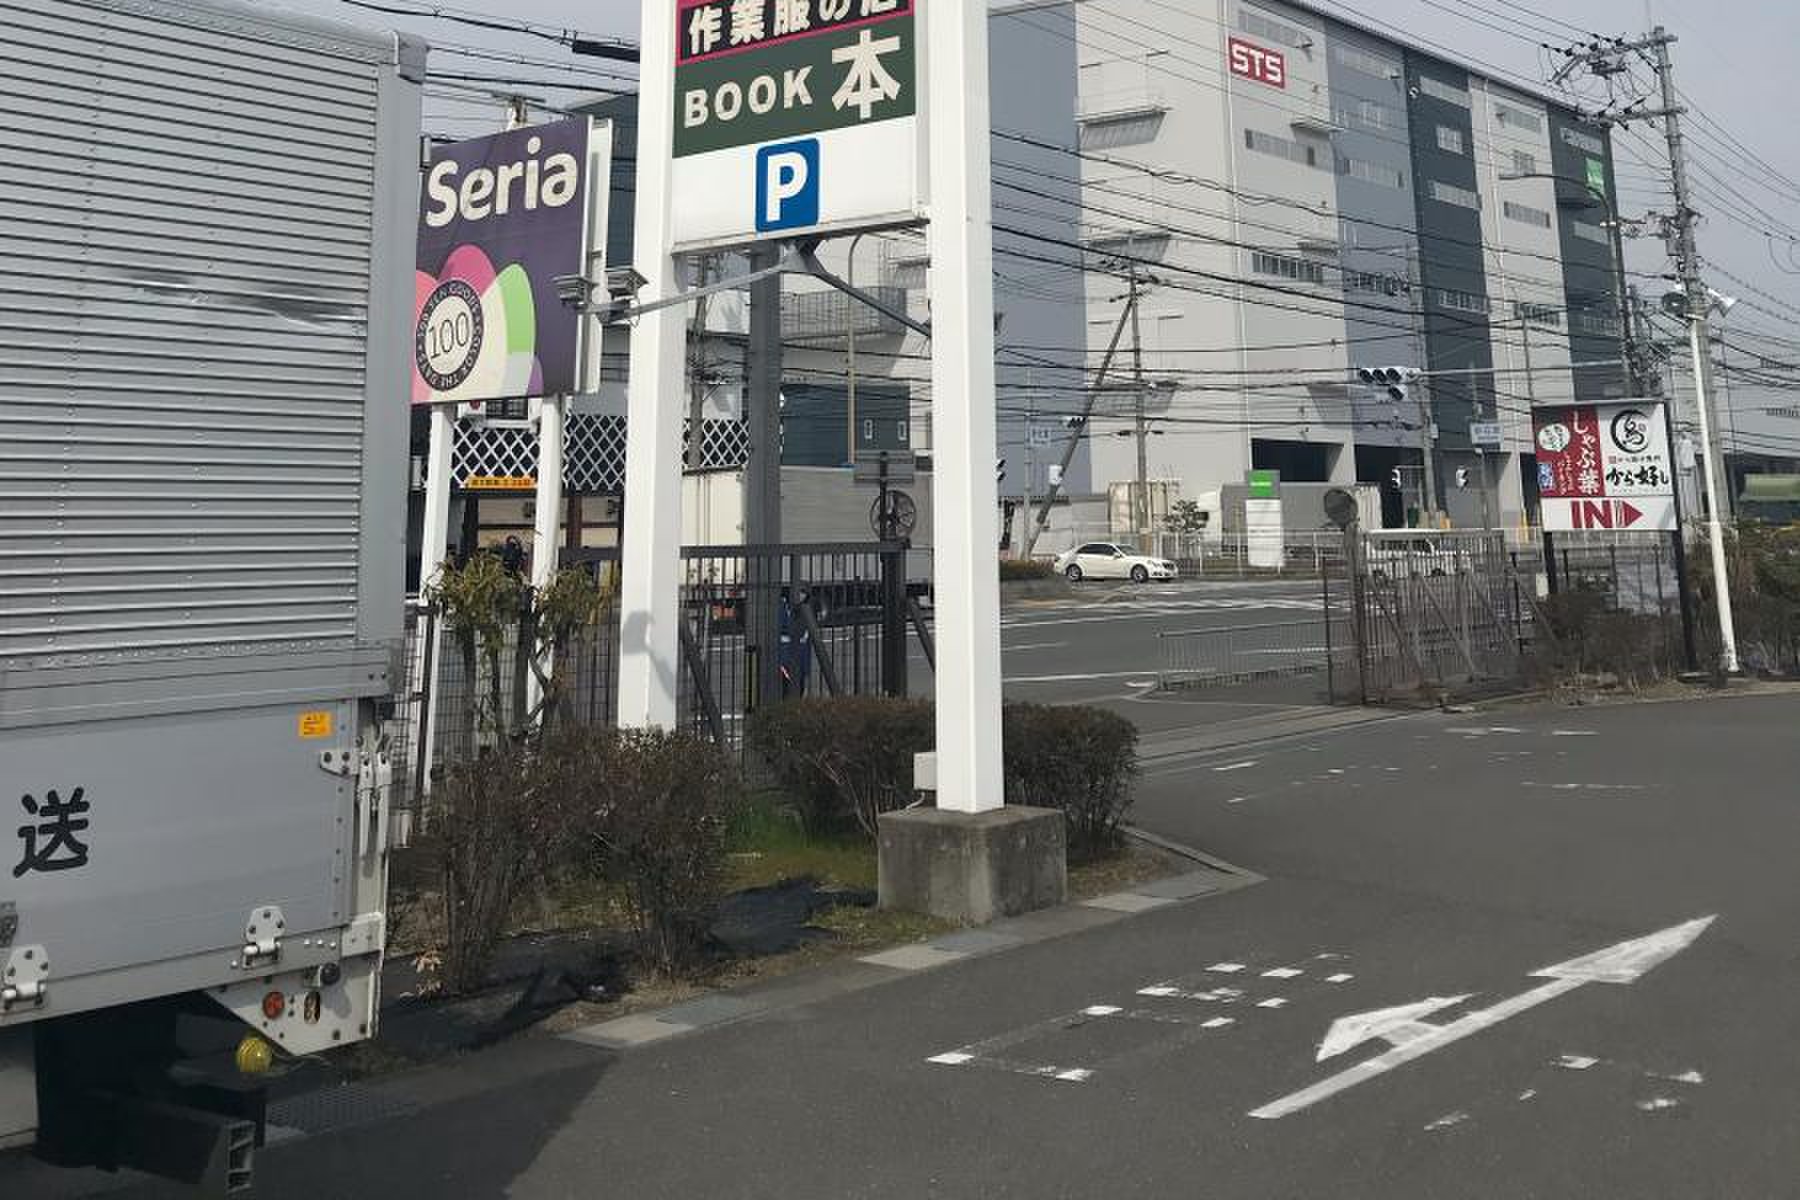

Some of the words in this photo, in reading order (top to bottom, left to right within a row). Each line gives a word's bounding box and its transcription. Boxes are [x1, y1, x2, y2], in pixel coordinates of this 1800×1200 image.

[683, 65, 814, 129] BOOK
[831, 29, 902, 120] 本
[1231, 43, 1282, 82] STS
[425, 136, 578, 228] Seria
[766, 152, 808, 222] P
[428, 311, 470, 360] 100
[1573, 411, 1600, 496] しゃぶ葉
[1605, 465, 1669, 487] から好し
[1570, 500, 1614, 529] IN
[12, 786, 90, 879] 送
